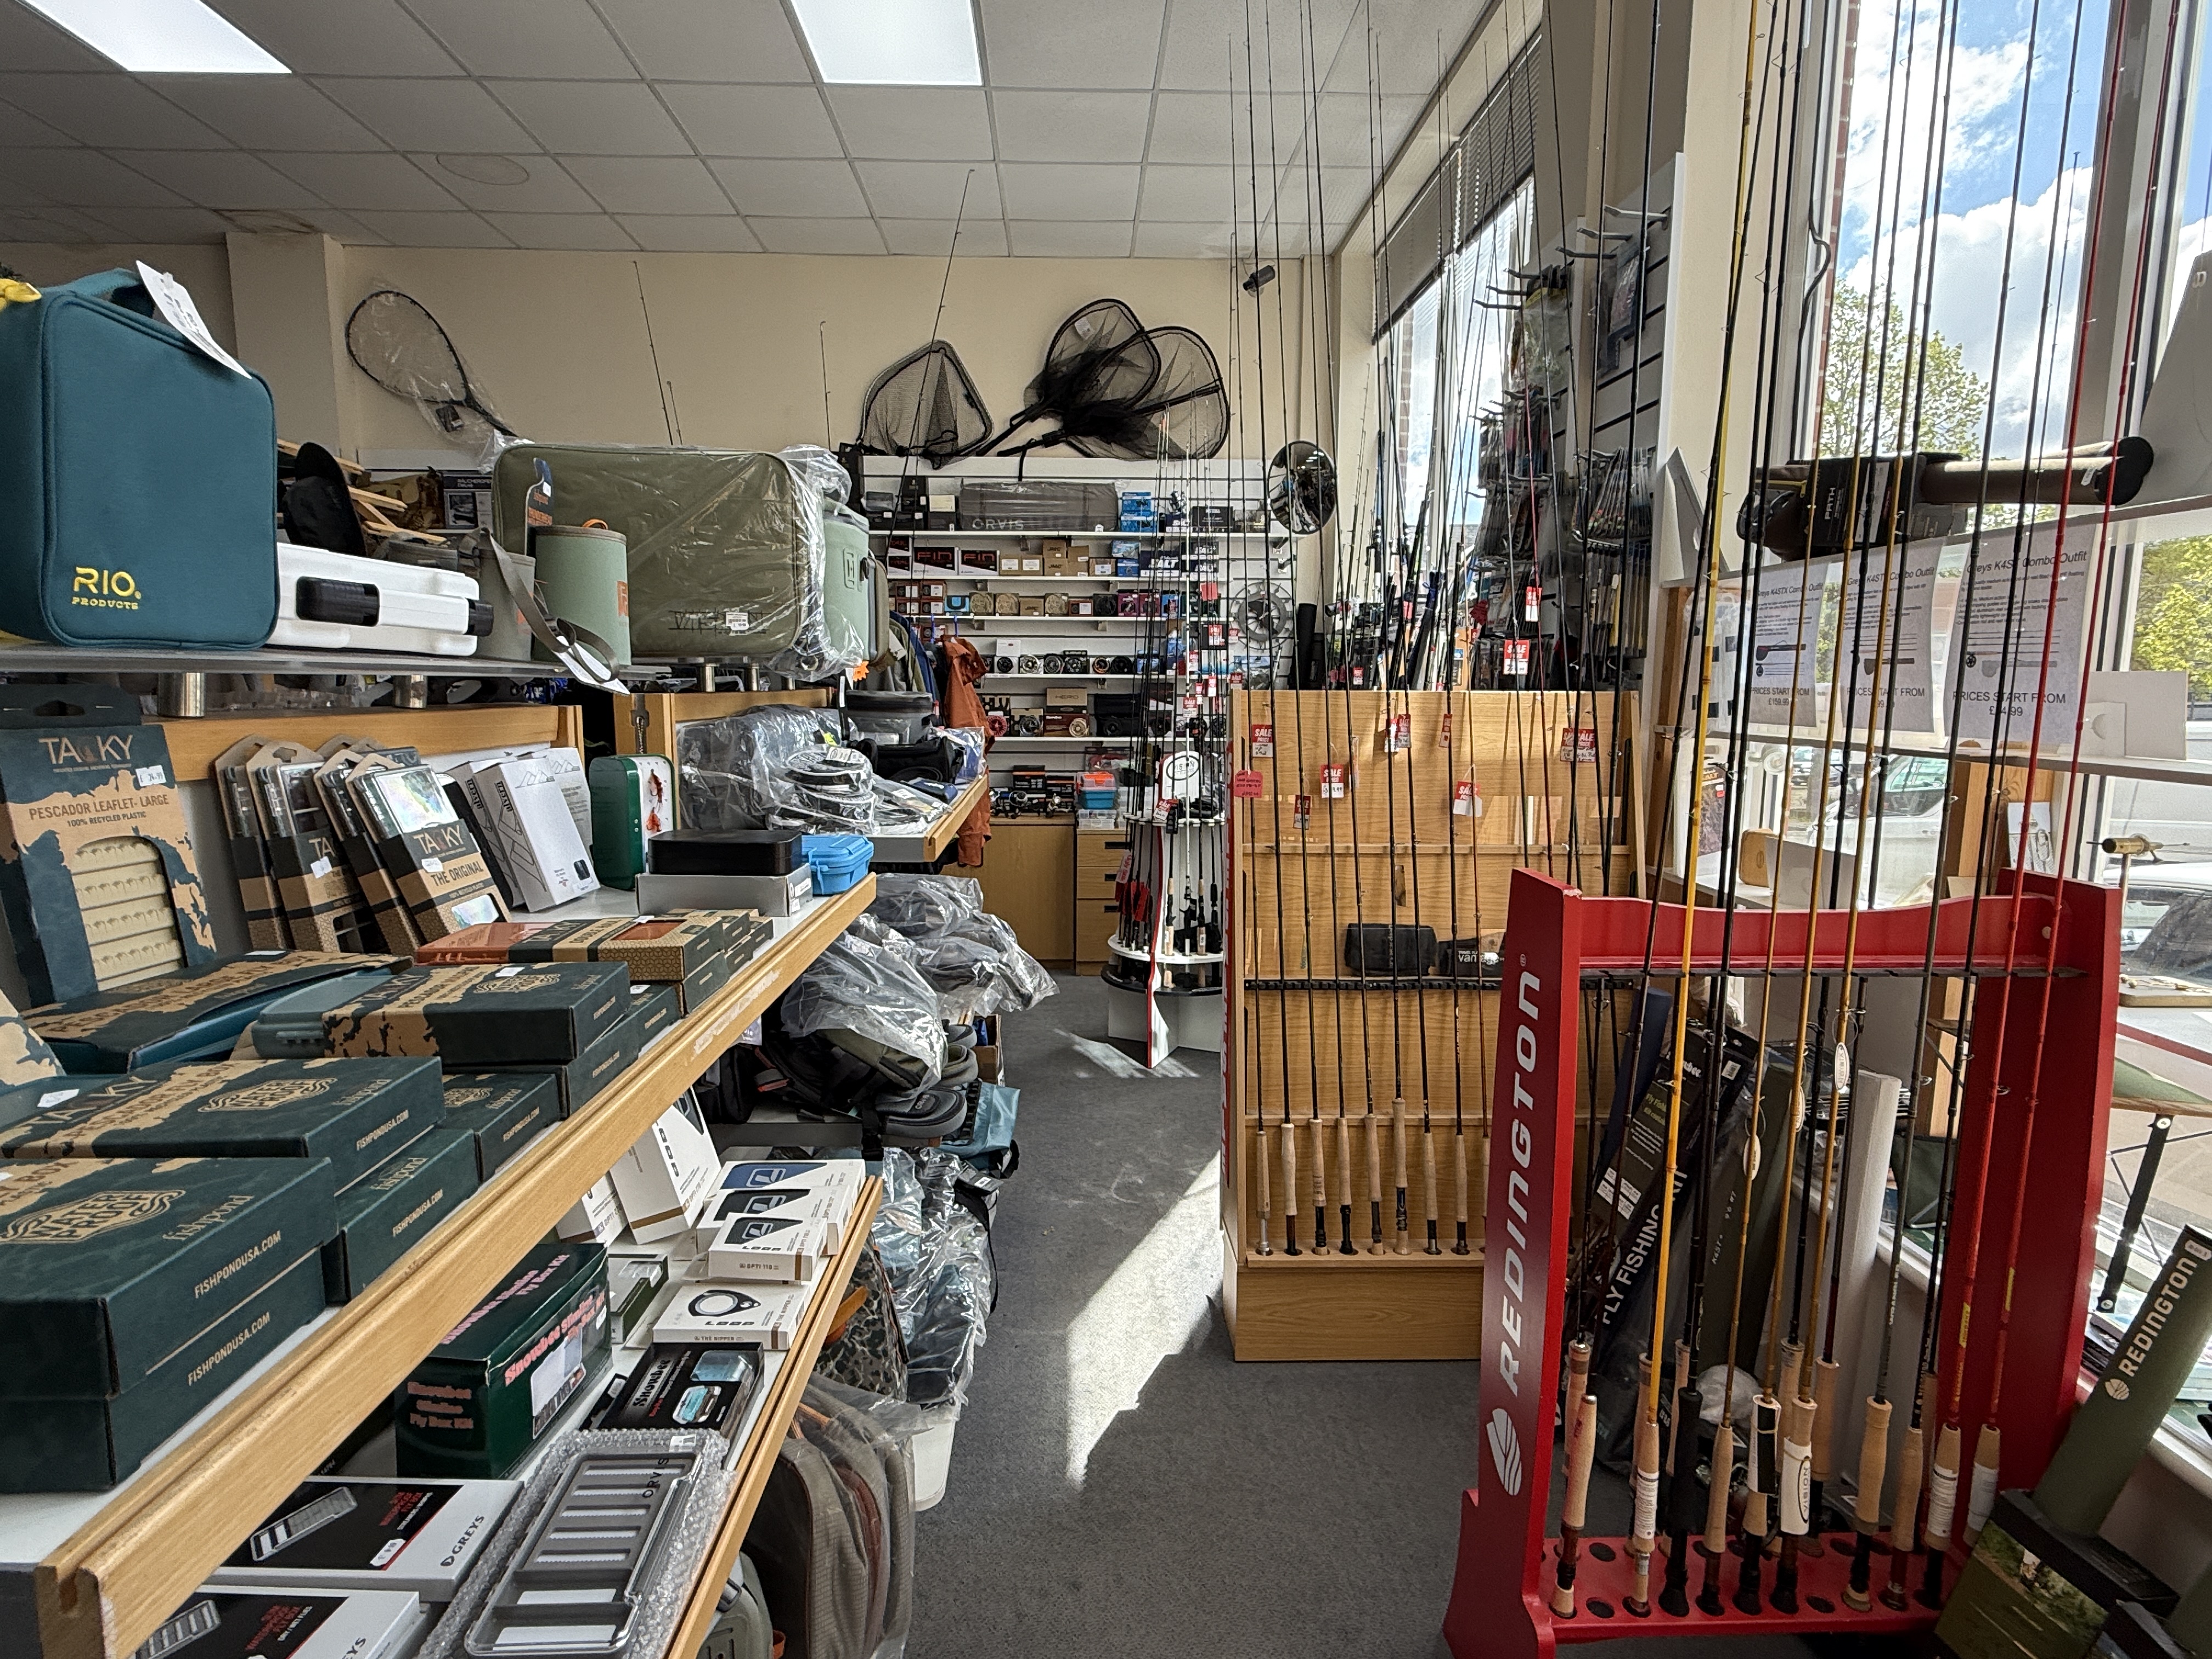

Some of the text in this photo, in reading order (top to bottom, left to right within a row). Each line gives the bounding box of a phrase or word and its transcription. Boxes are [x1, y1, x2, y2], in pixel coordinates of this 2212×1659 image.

[1824, 487, 1836, 520] PATH
[972, 518, 1024, 530] ORVIS
[2059, 551, 2088, 563] Outfit
[74, 566, 135, 597] RIO
[71, 597, 138, 610] PRODUCTS
[1900, 687, 1925, 697] FROM
[2031, 693, 2066, 703] FOM
[1255, 729, 1272, 737] SALE
[1323, 769, 1342, 777] SLE
[29, 802, 91, 820] PESCADOR
[139, 794, 170, 808] LARGE
[122, 811, 146, 821] PLASTIC
[431, 861, 484, 887] THE ORIGINAL
[1458, 952, 1499, 965] vanage
[26, 1076, 157, 1124] TAKY
[356, 1109, 409, 1151] FISHPONDUSA.COM
[370, 1158, 428, 1190] fishpond
[1499, 970, 1541, 1397] REDINGTON
[28, 1194, 123, 1238] WATER
[54, 1194, 150, 1238] PROOF
[162, 1194, 255, 1241] fishpond
[392, 1189, 443, 1237] FISHPONDUSA.COM
[194, 1231, 282, 1299] FISHPONDUSA.COM
[2118, 1257, 2198, 1378] REDINGTON
[188, 1311, 271, 1387] FISHPONDUSA.COM
[505, 1325, 561, 1387] Snowbee
[633, 1359, 670, 1407] Snowbee
[642, 1458, 669, 1498] ORVIS
[452, 1515, 485, 1554] GREYS
